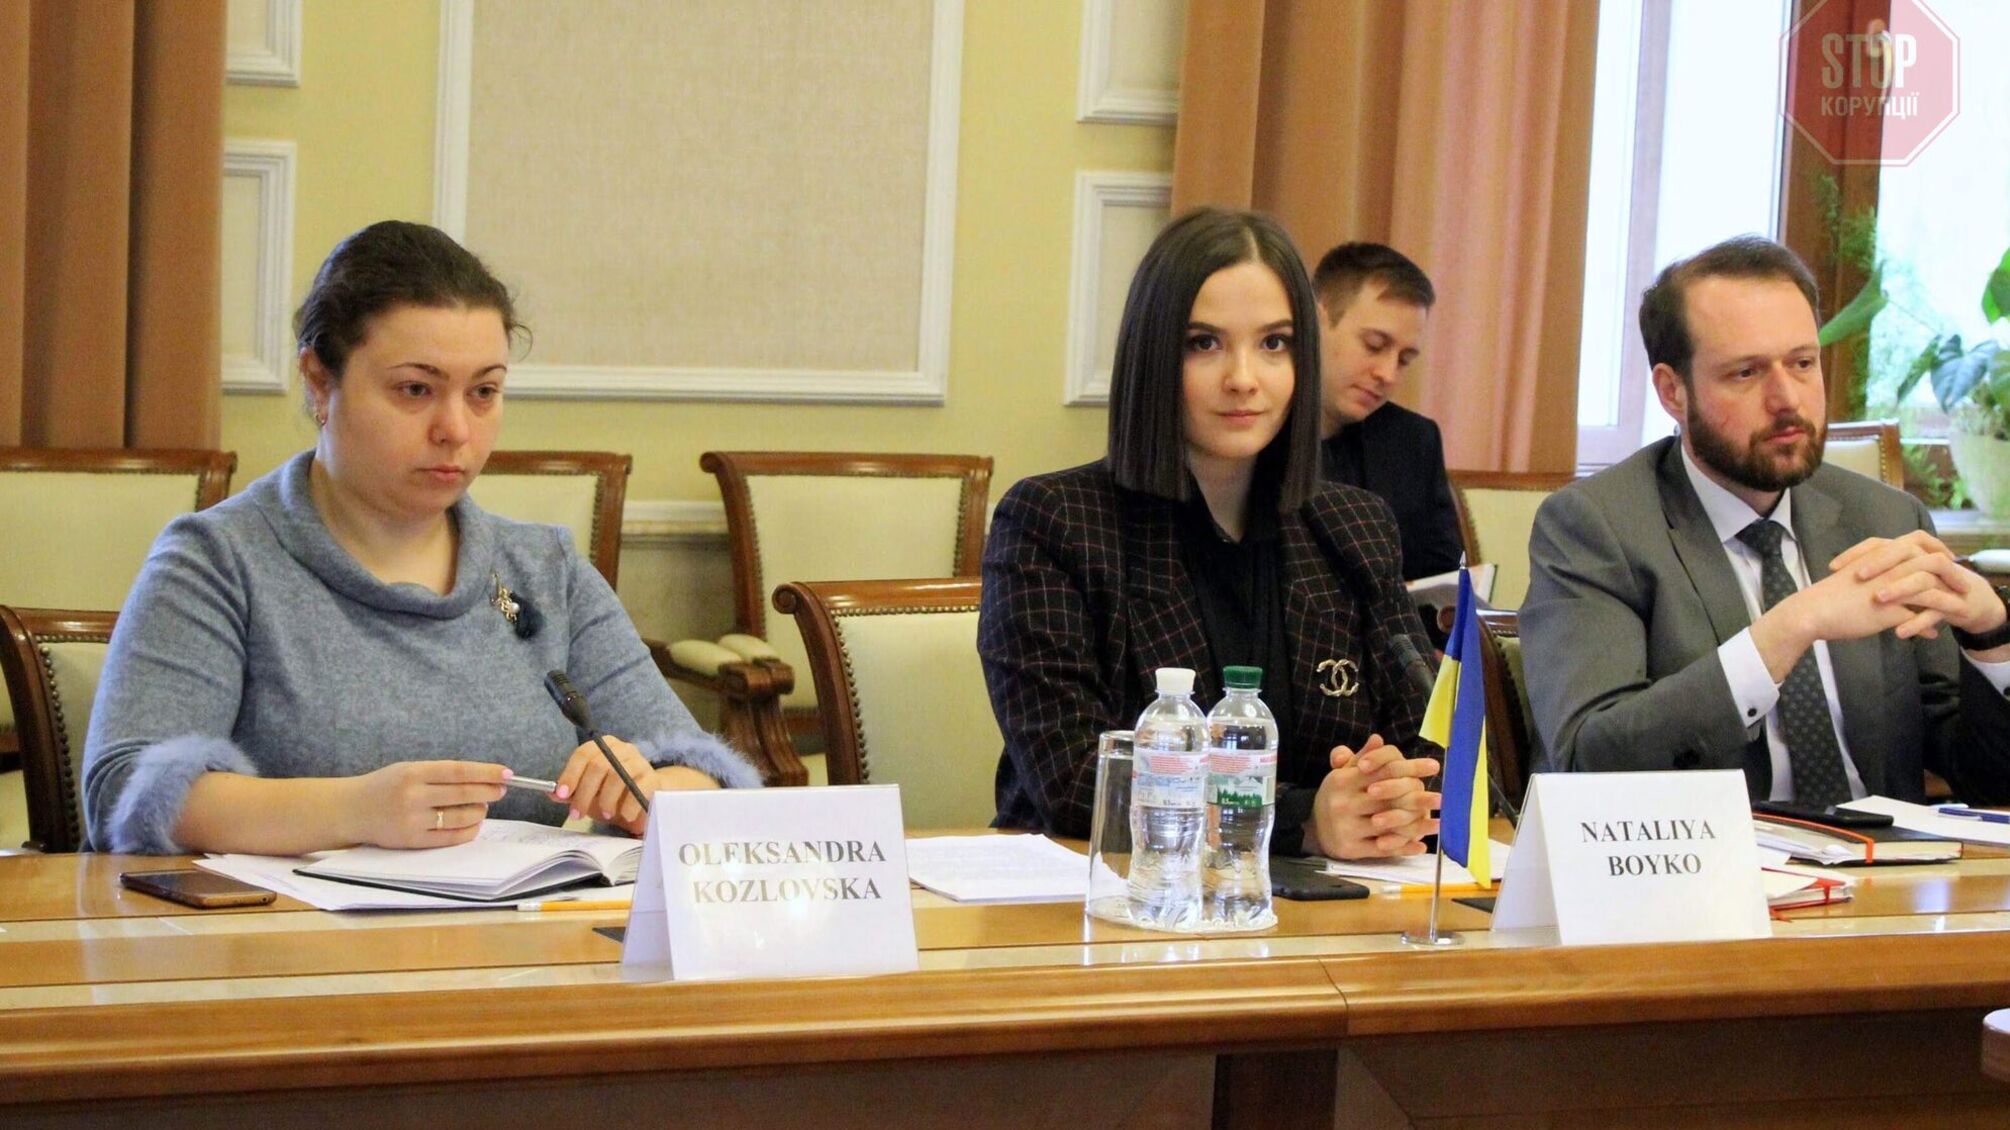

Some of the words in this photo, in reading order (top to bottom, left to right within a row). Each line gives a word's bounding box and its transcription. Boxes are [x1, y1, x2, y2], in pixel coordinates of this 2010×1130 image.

[1580, 819, 1716, 843] NATALIYA
[678, 840, 886, 867] OLEKSANDRA
[1608, 853, 1702, 877] BOYKO
[693, 877, 882, 903] KOZLOVSKA
